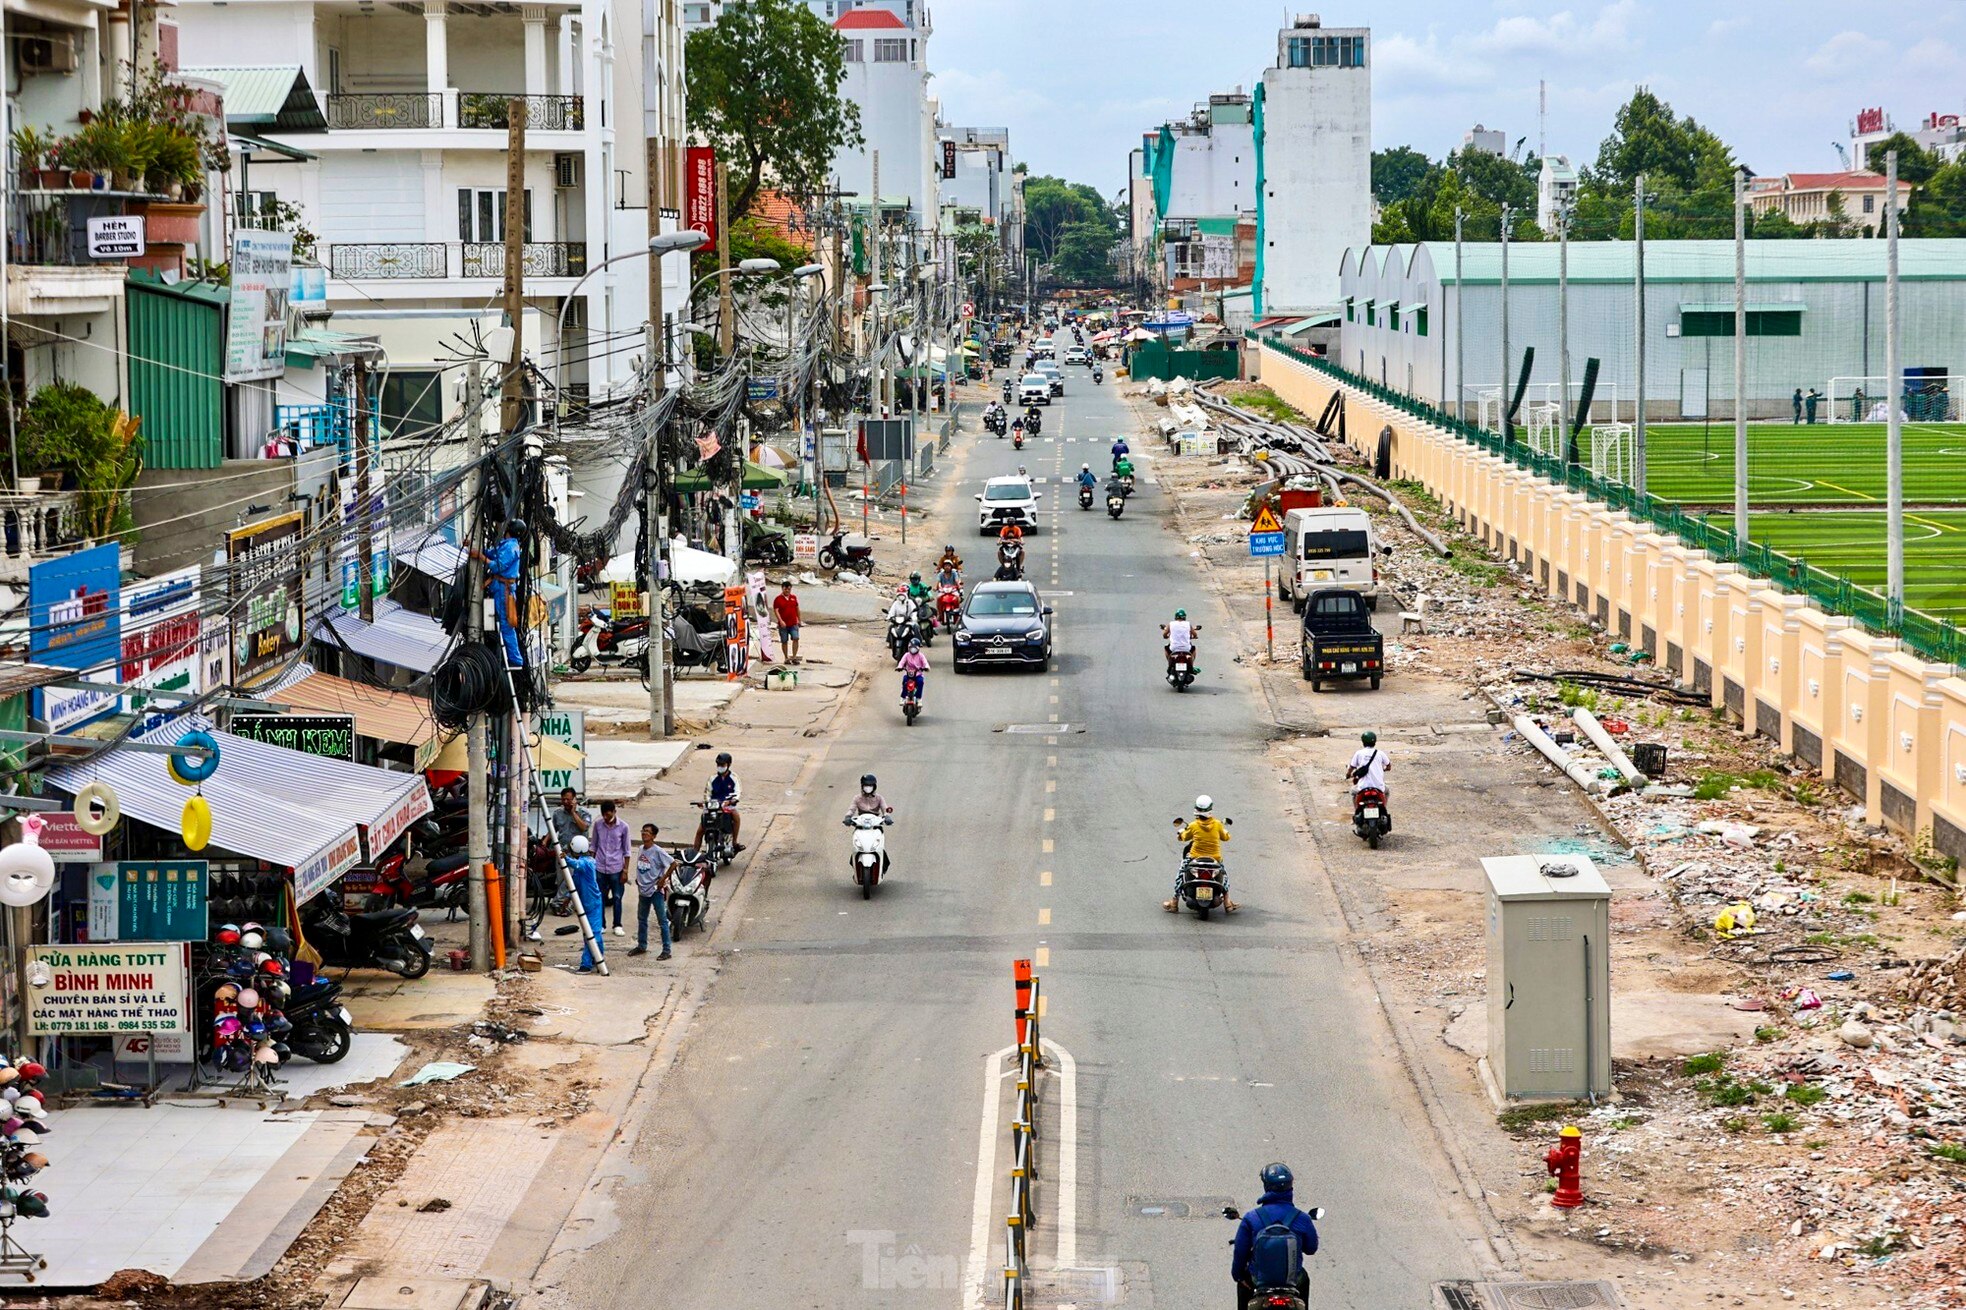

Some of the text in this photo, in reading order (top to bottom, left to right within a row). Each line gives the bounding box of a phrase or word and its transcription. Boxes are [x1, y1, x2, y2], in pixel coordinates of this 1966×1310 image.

[945, 143, 954, 177] HOTEL
[698, 158, 707, 222] 02822 688 688
[95, 231, 136, 241] BARBER STUDIO
[258, 631, 280, 657] Bakery
[51, 700, 67, 721] MINH
[68, 691, 89, 714] HOÀNG
[541, 714, 572, 735] NHÀ
[302, 729, 348, 756] KEM
[45, 822, 82, 832] viette
[39, 950, 167, 967] CỬA HÀNG TDTT
[55, 970, 153, 991] BÌNH MINH
[43, 992, 165, 1004] CHUYÊN BÁN SỈ VÀ LẺ
[33, 1005, 177, 1020] CÁC MẶT HÀNG THỂ THAO
[35, 1022, 49, 1031] LH:
[51, 1021, 72, 1030] 0779
[75, 1021, 90, 1030] 181
[93, 1021, 109, 1030] 168
[118, 1021, 139, 1030] 0984
[142, 1020, 158, 1029] 535
[161, 1020, 176, 1029] 528
[126, 1038, 149, 1053] 4G
